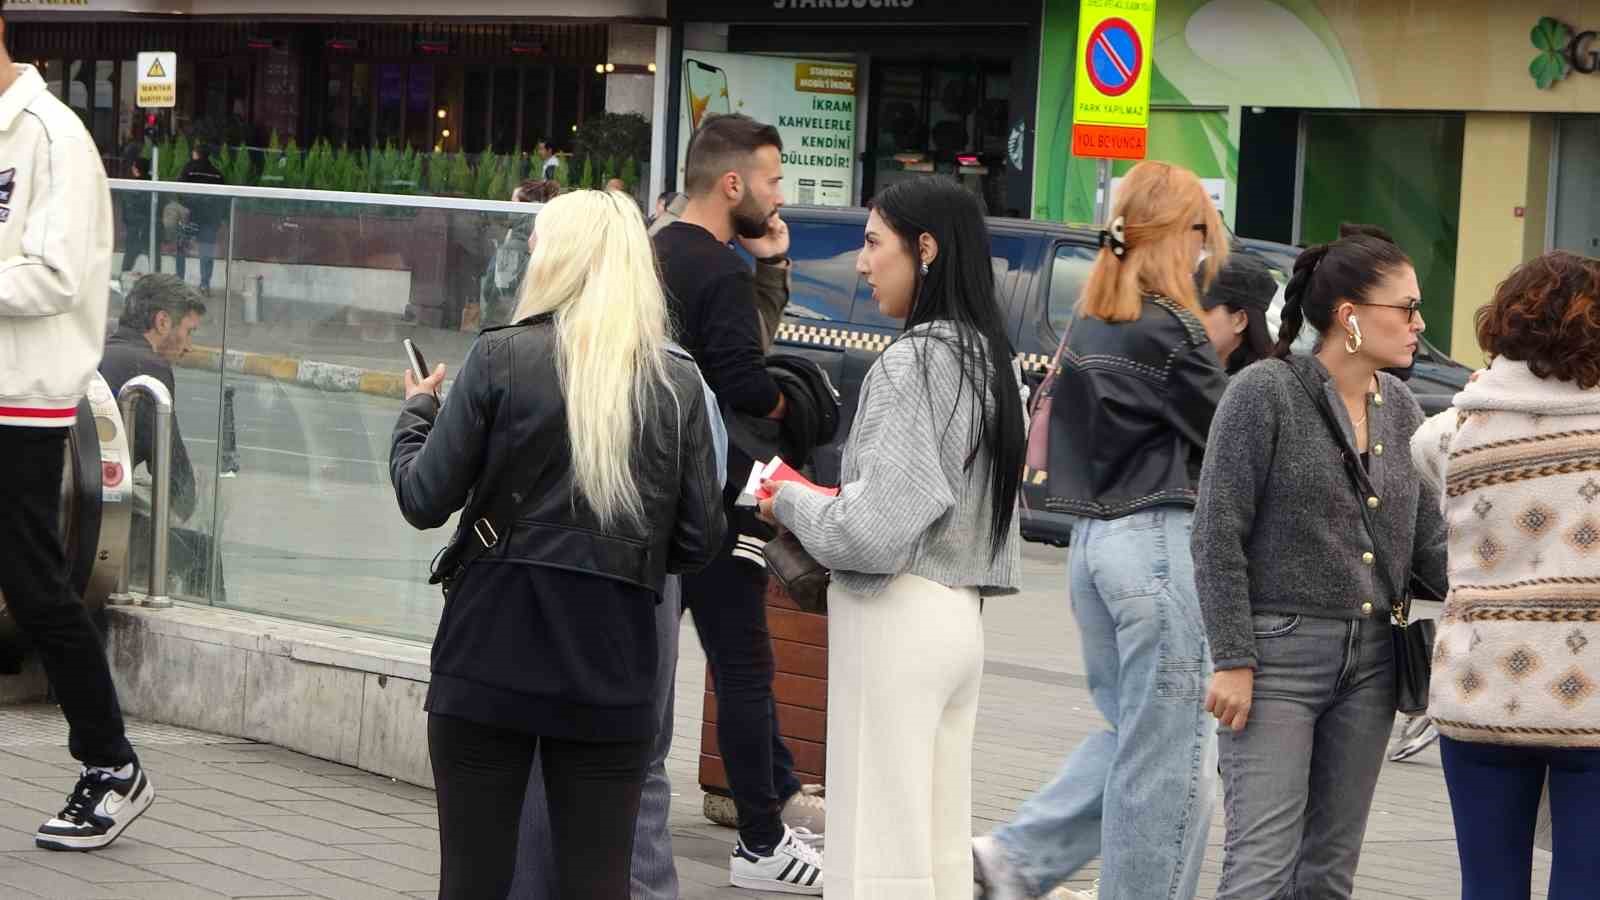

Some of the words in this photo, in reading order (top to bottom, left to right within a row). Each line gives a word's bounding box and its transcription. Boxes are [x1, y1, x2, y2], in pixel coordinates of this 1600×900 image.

[811, 95, 853, 113] İKRAM
[1079, 103, 1100, 113] PARK
[1103, 104, 1144, 116] YAPILMAZ
[778, 115, 852, 131] KAHVELERLE
[801, 134, 851, 150] KENDİNİ
[1077, 133, 1096, 148] YOL
[1096, 134, 1145, 150] BOYUNCA
[780, 151, 850, 169] DÜLLENDİR!
